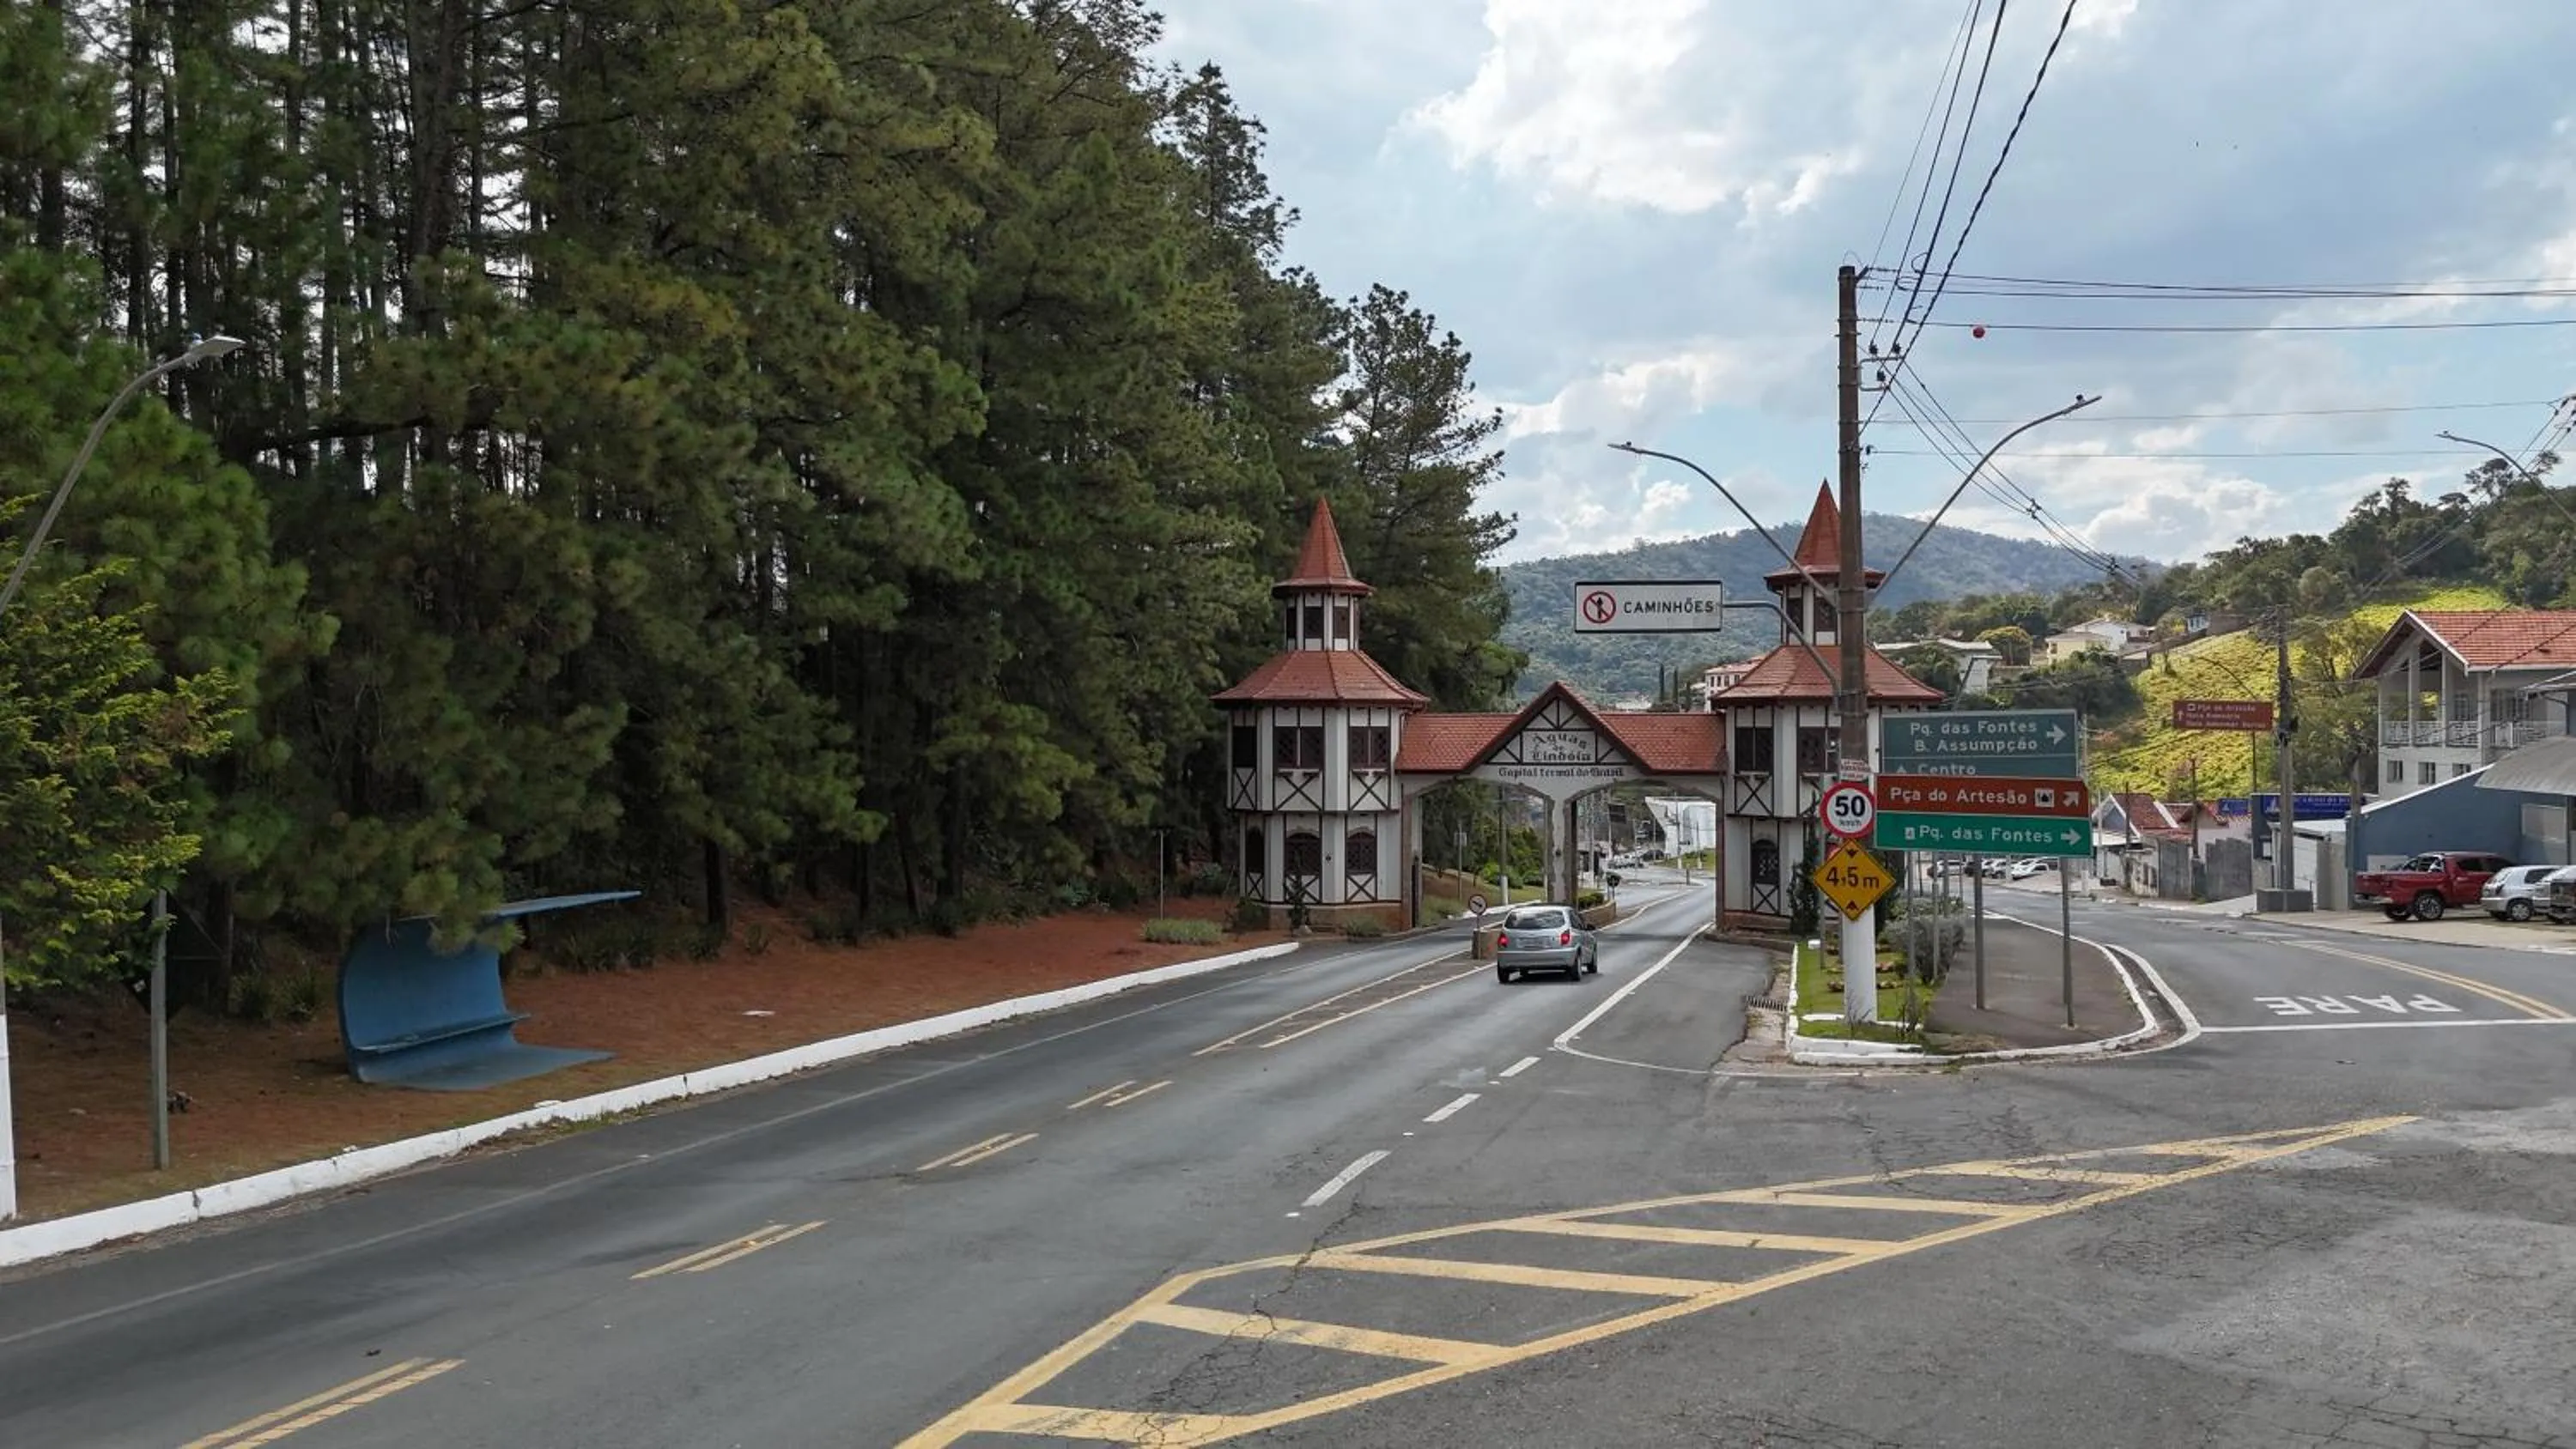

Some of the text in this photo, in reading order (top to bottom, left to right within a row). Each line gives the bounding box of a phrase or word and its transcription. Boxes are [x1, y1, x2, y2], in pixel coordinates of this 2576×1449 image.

[1624, 597, 1714, 614] CAMINHÕES
[1910, 720, 2038, 737] Pq. das Fontes
[1914, 737, 2038, 753] B. Assumpção
[1917, 763, 1977, 775] Centro
[1890, 787, 2027, 803] Pça do Artesão
[1835, 795, 1866, 816] 50
[1919, 825, 2053, 842] Pq. das Fontes
[1862, 876, 1880, 888] m
[2253, 994, 2462, 1016] PARE
